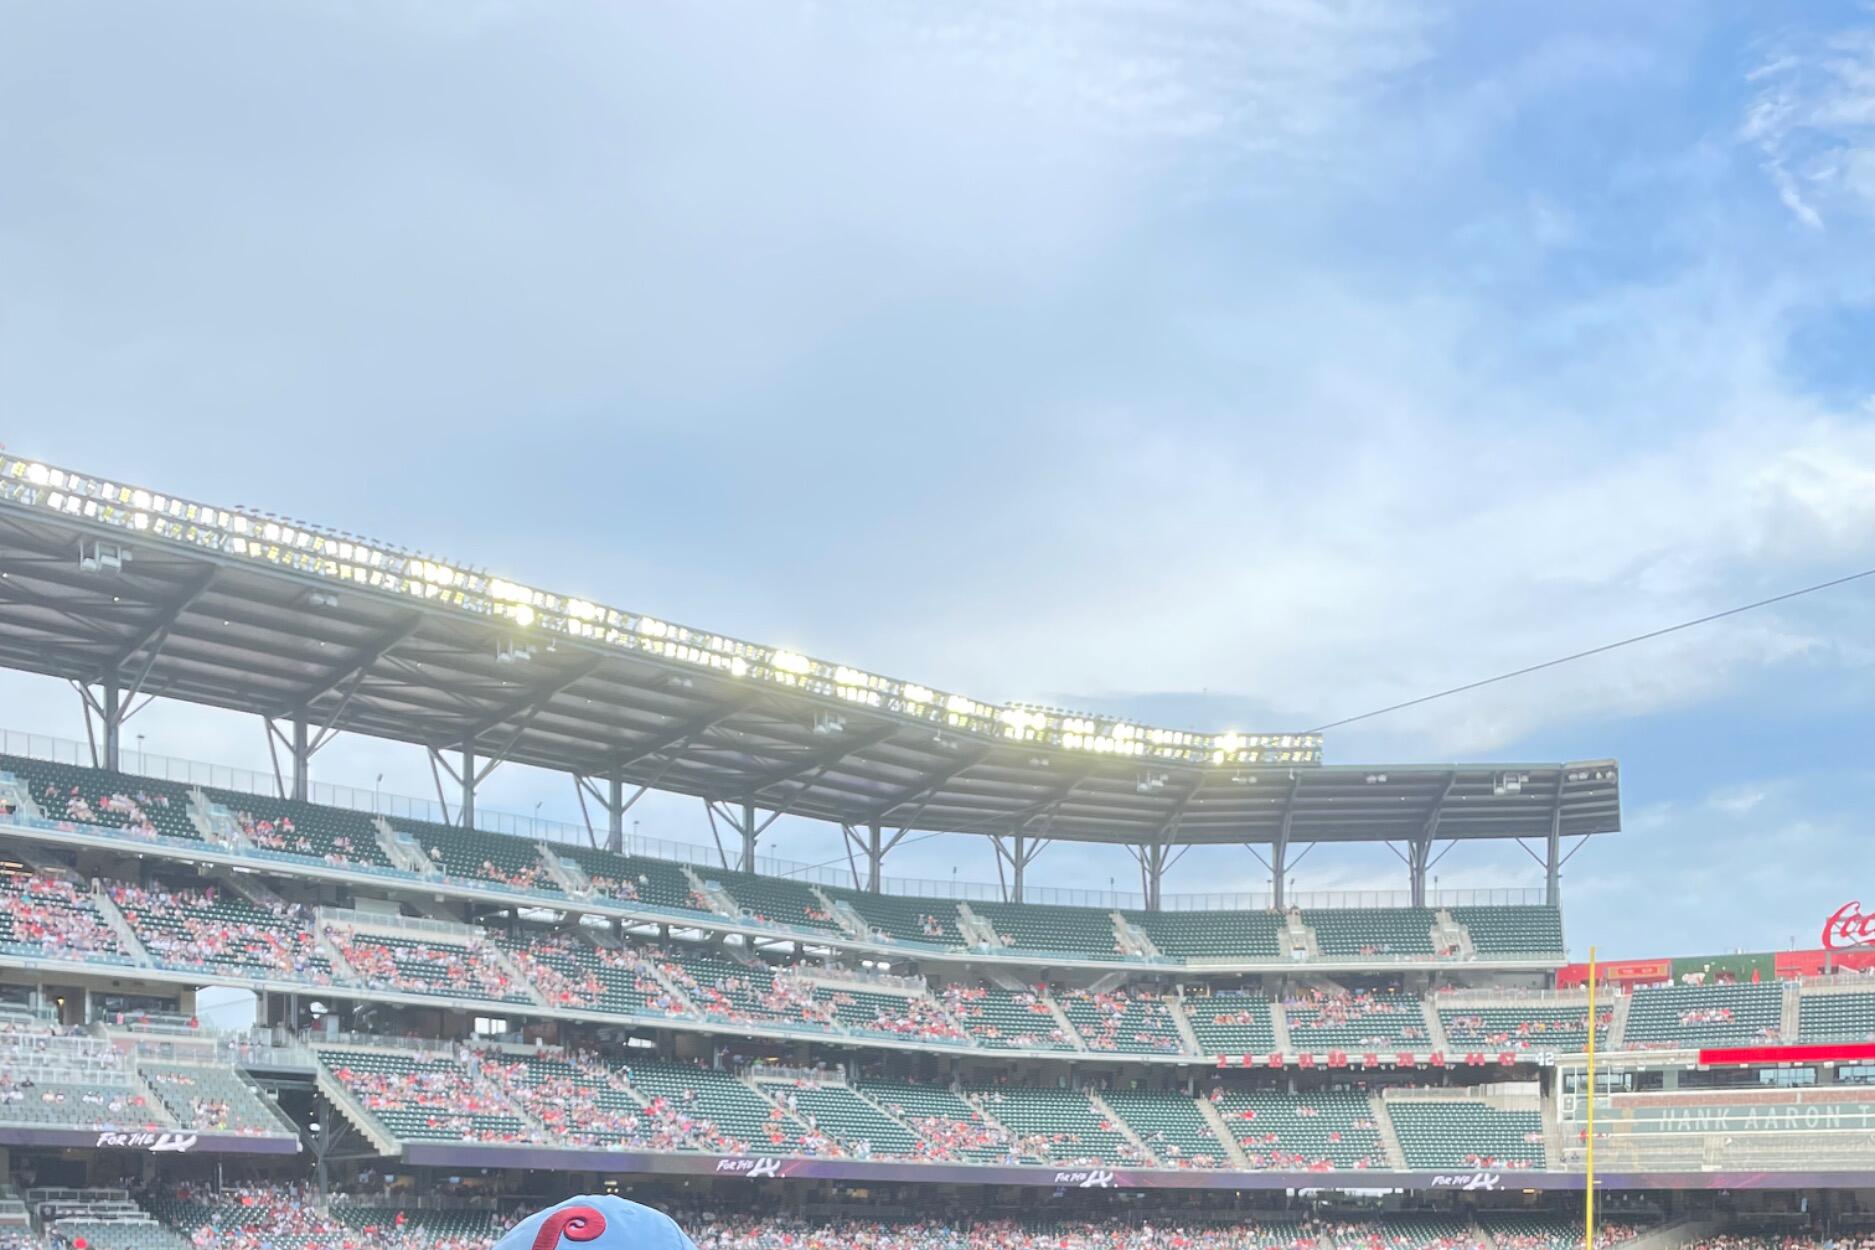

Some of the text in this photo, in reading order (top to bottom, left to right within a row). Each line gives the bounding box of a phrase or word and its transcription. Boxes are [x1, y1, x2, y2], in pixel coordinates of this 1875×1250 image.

[1535, 1052, 1555, 1067] 42
[1659, 1108, 1730, 1131] HANK
[1744, 1105, 1841, 1130] AARON
[97, 1132, 127, 1147] FOR
[716, 1159, 737, 1172] FOR
